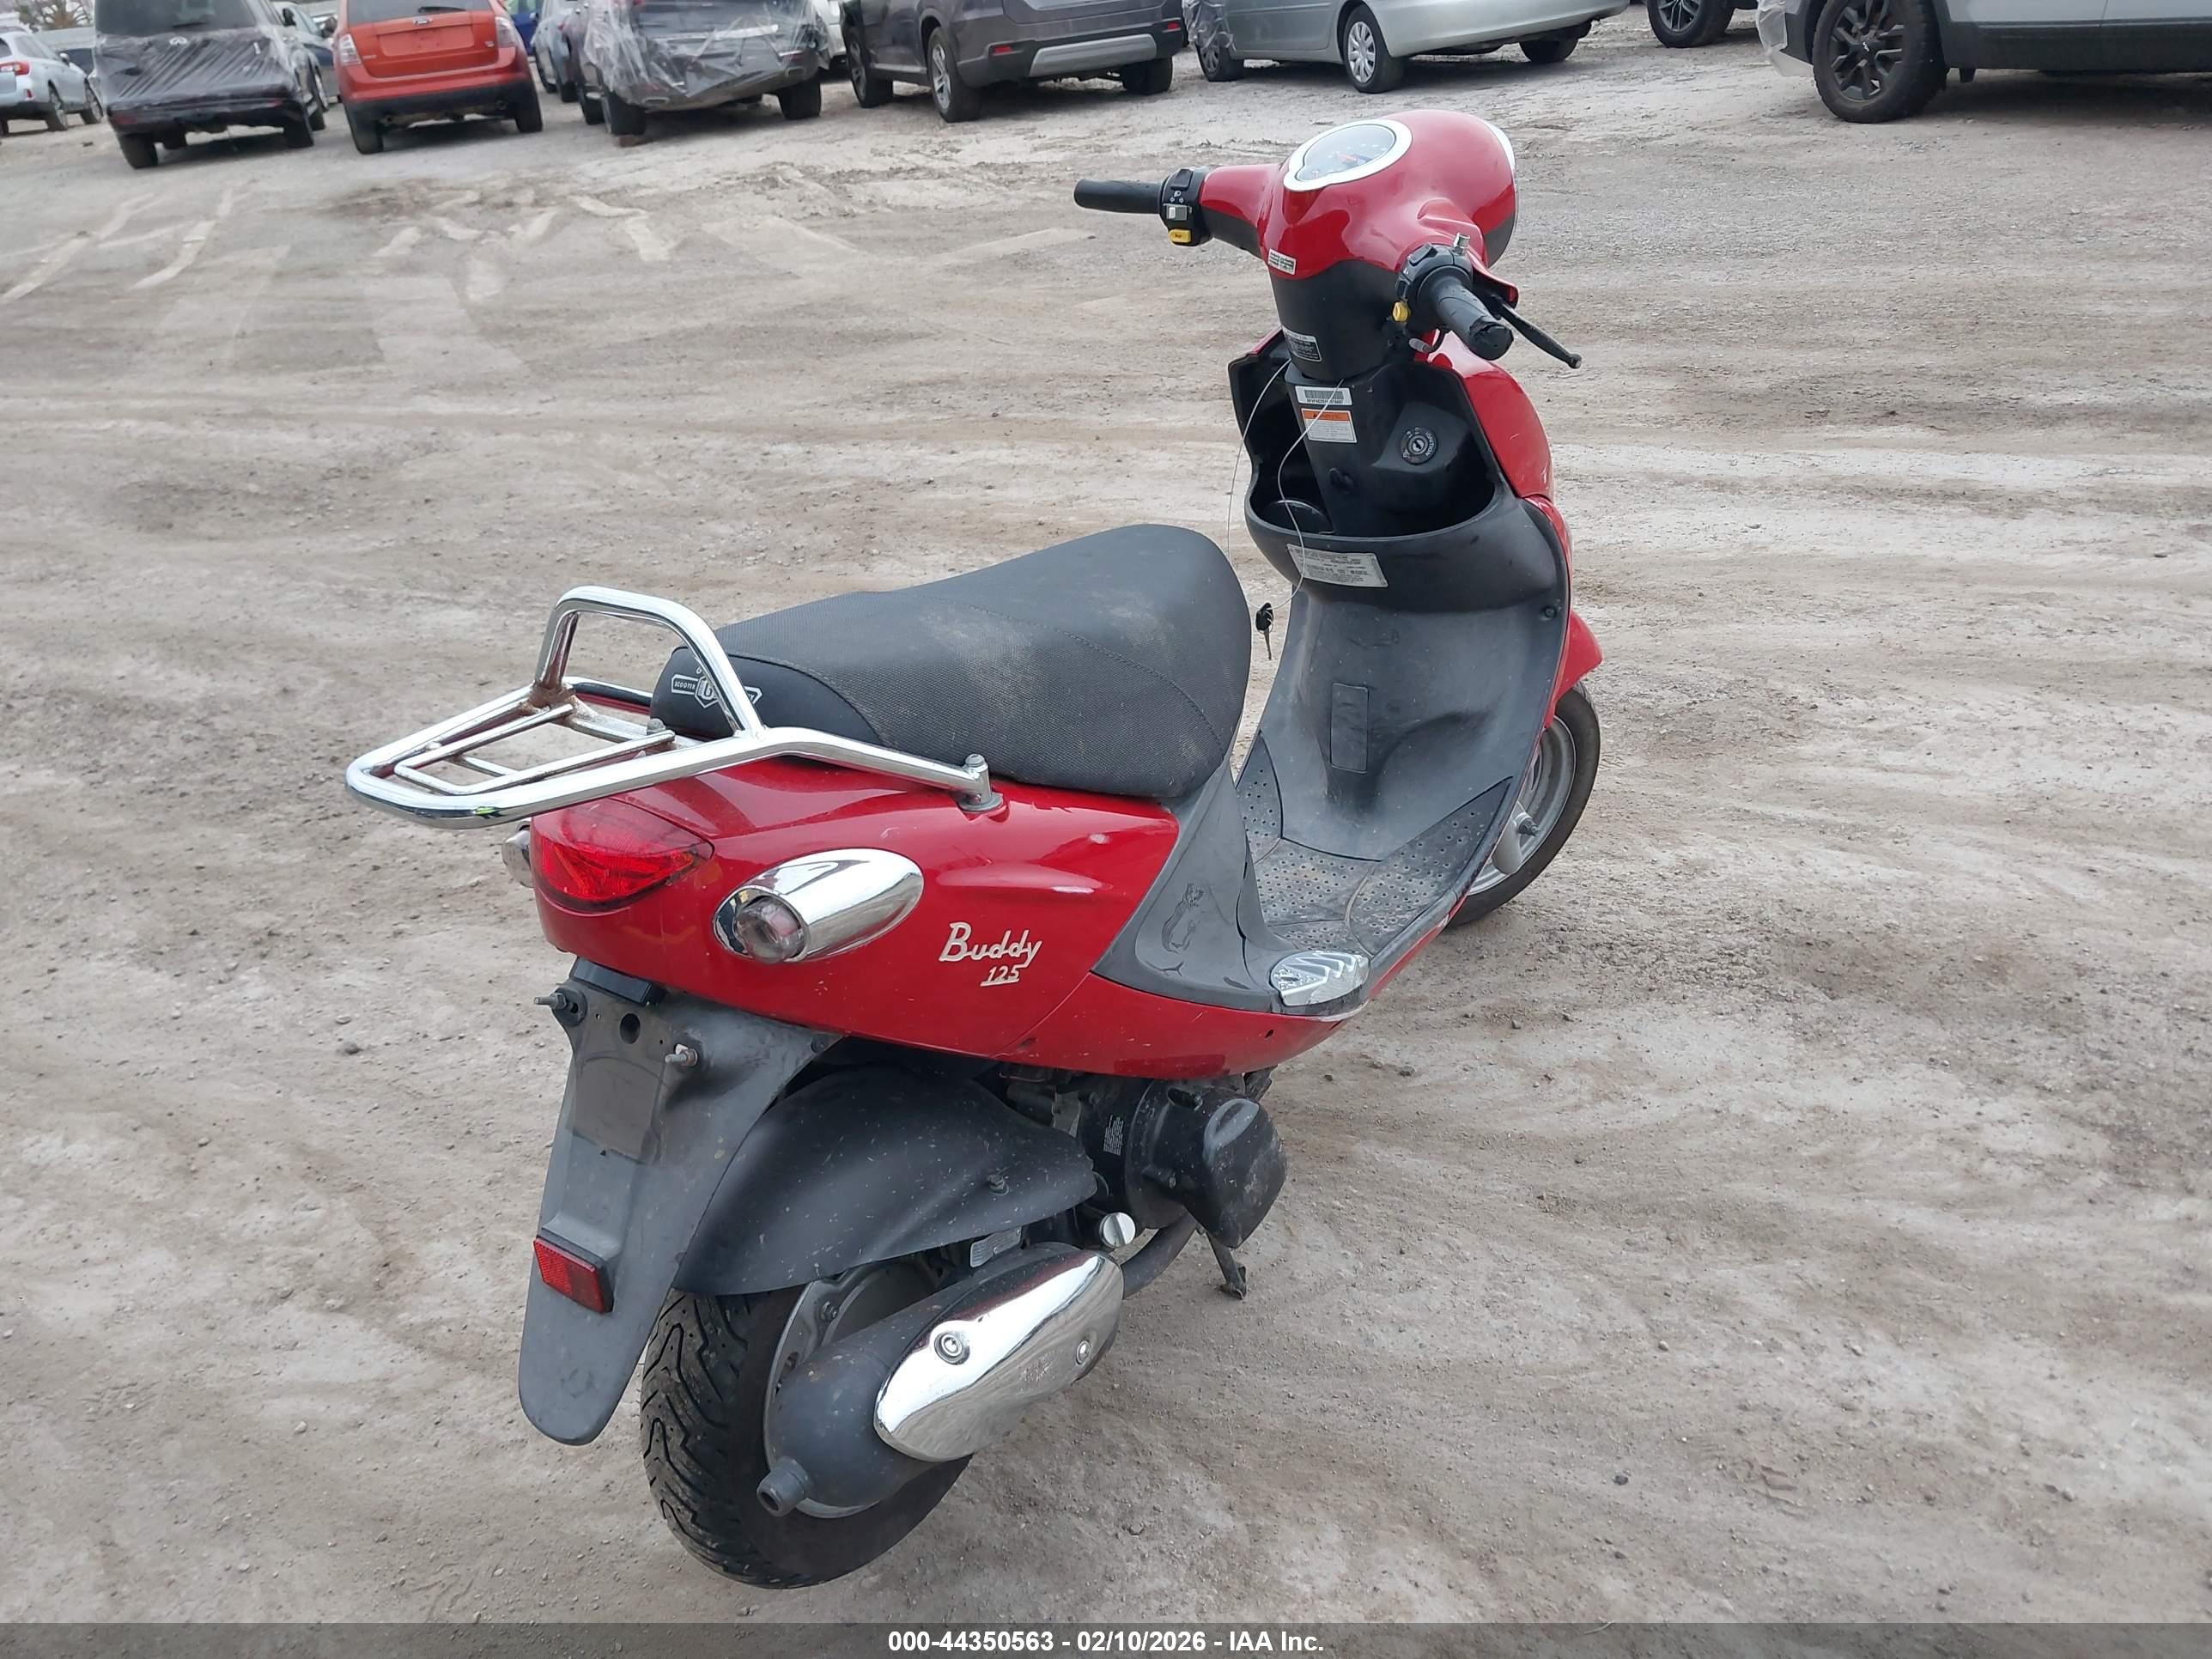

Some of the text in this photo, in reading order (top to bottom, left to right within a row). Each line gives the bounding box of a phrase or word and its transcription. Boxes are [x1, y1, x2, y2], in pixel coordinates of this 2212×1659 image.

[674, 680, 696, 690] SCOOTER
[938, 921, 1043, 968] Buddy
[985, 965, 1020, 985] 125
